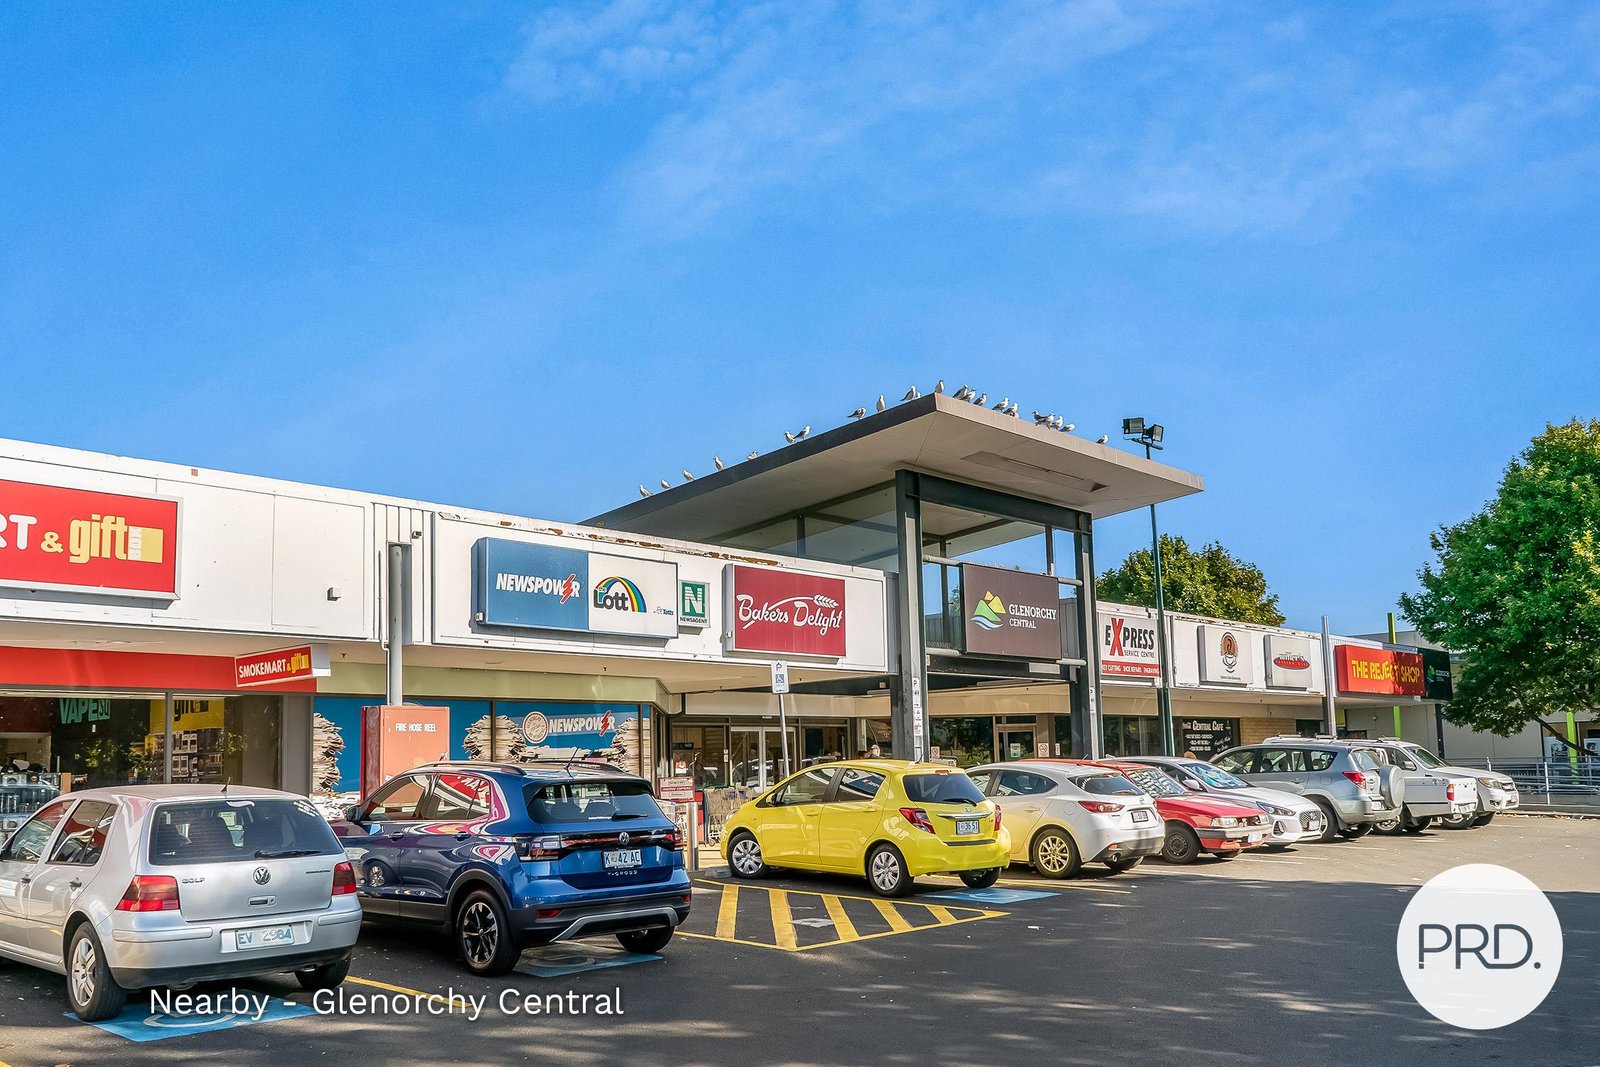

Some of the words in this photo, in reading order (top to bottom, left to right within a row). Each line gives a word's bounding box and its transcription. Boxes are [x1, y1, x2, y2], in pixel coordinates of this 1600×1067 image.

[40, 531, 64, 554] &
[69, 513, 128, 564] gift
[593, 588, 628, 611] Lott
[679, 616, 708, 624] NEWSAGENT
[736, 594, 789, 626] Bakers
[793, 600, 843, 636] Delight
[1008, 603, 1057, 620] GLENORCHY
[1008, 618, 1037, 629] CENTRAL
[1105, 617, 1155, 656] EXPRESS
[239, 658, 287, 678] SMOKEMART
[1352, 659, 1369, 678] THE
[1370, 660, 1399, 681] REJECT
[1401, 665, 1420, 683] SHOP
[395, 722, 407, 731] FIRE
[409, 723, 423, 731] HOSE
[424, 723, 437, 732] REEL
[238, 932, 253, 944] EV
[262, 928, 292, 942] 2984
